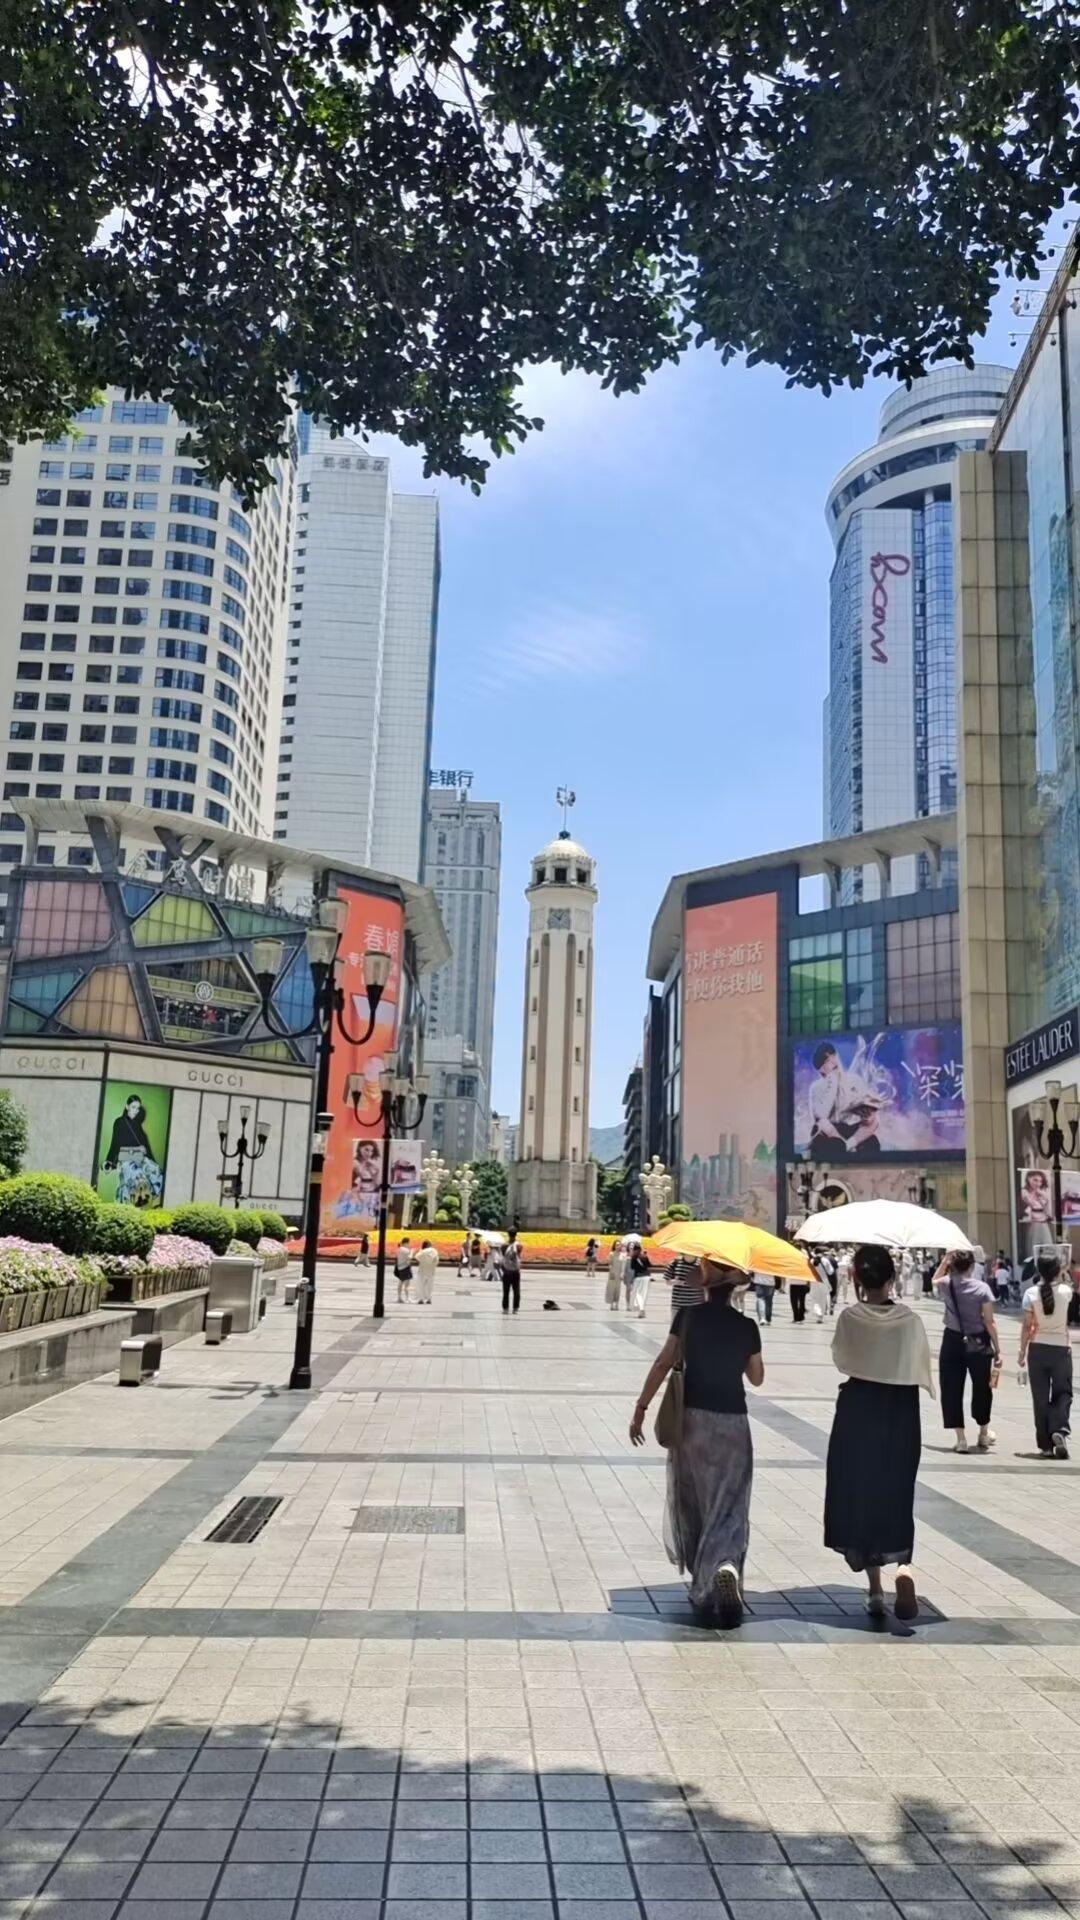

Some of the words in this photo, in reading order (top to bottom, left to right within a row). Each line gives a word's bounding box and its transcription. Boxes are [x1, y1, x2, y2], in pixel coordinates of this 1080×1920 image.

[1032, 1020, 1073, 1066] LAUDER
[16, 1055, 86, 1071] GUCCI
[188, 1068, 245, 1088] GUCCI
